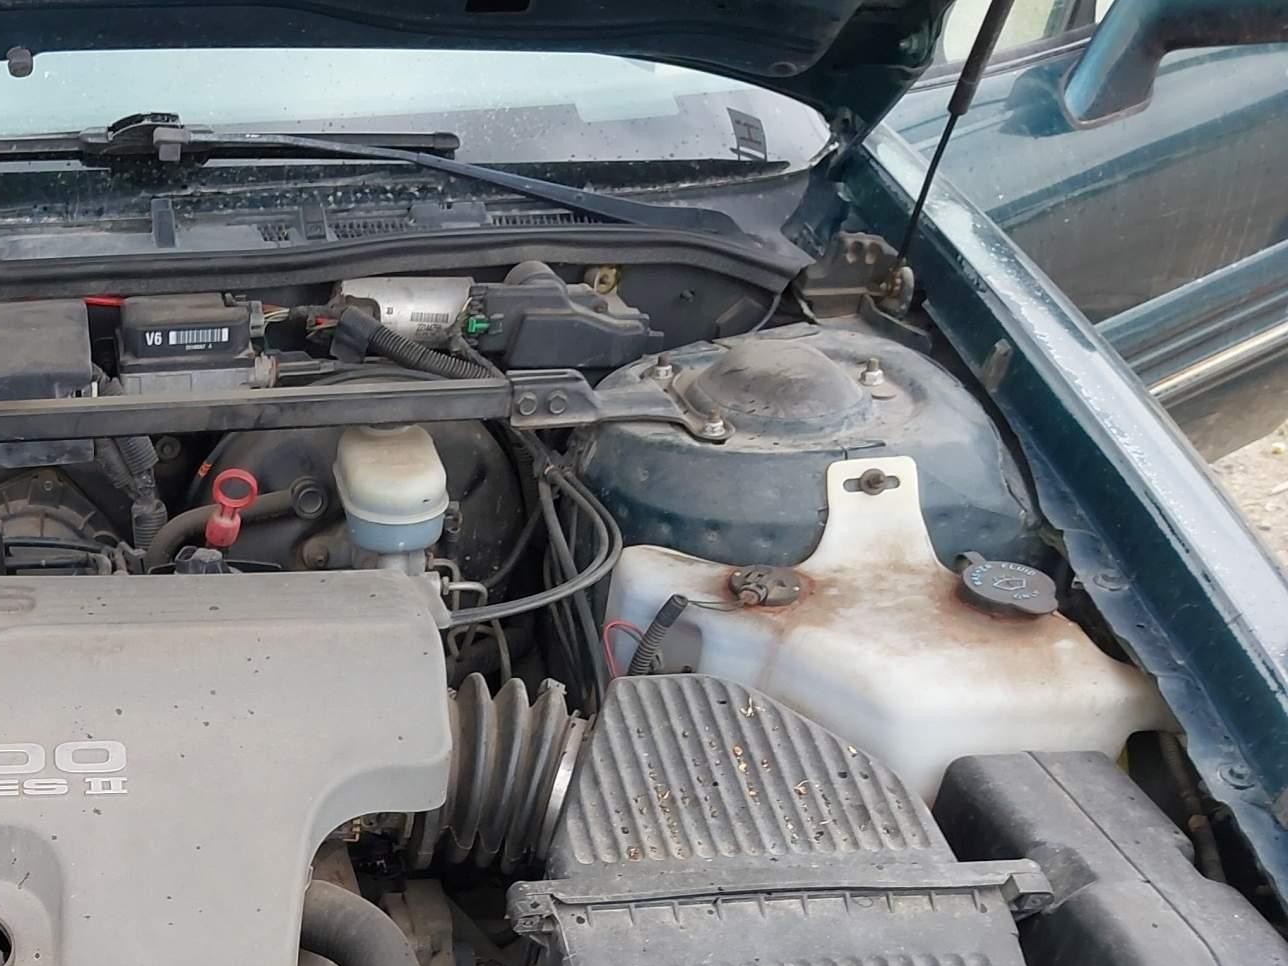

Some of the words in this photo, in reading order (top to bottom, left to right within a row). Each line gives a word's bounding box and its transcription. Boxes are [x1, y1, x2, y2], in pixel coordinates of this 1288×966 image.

[145, 331, 162, 346] V6
[1001, 563, 1037, 576] FLUID
[84, 777, 128, 795] II
